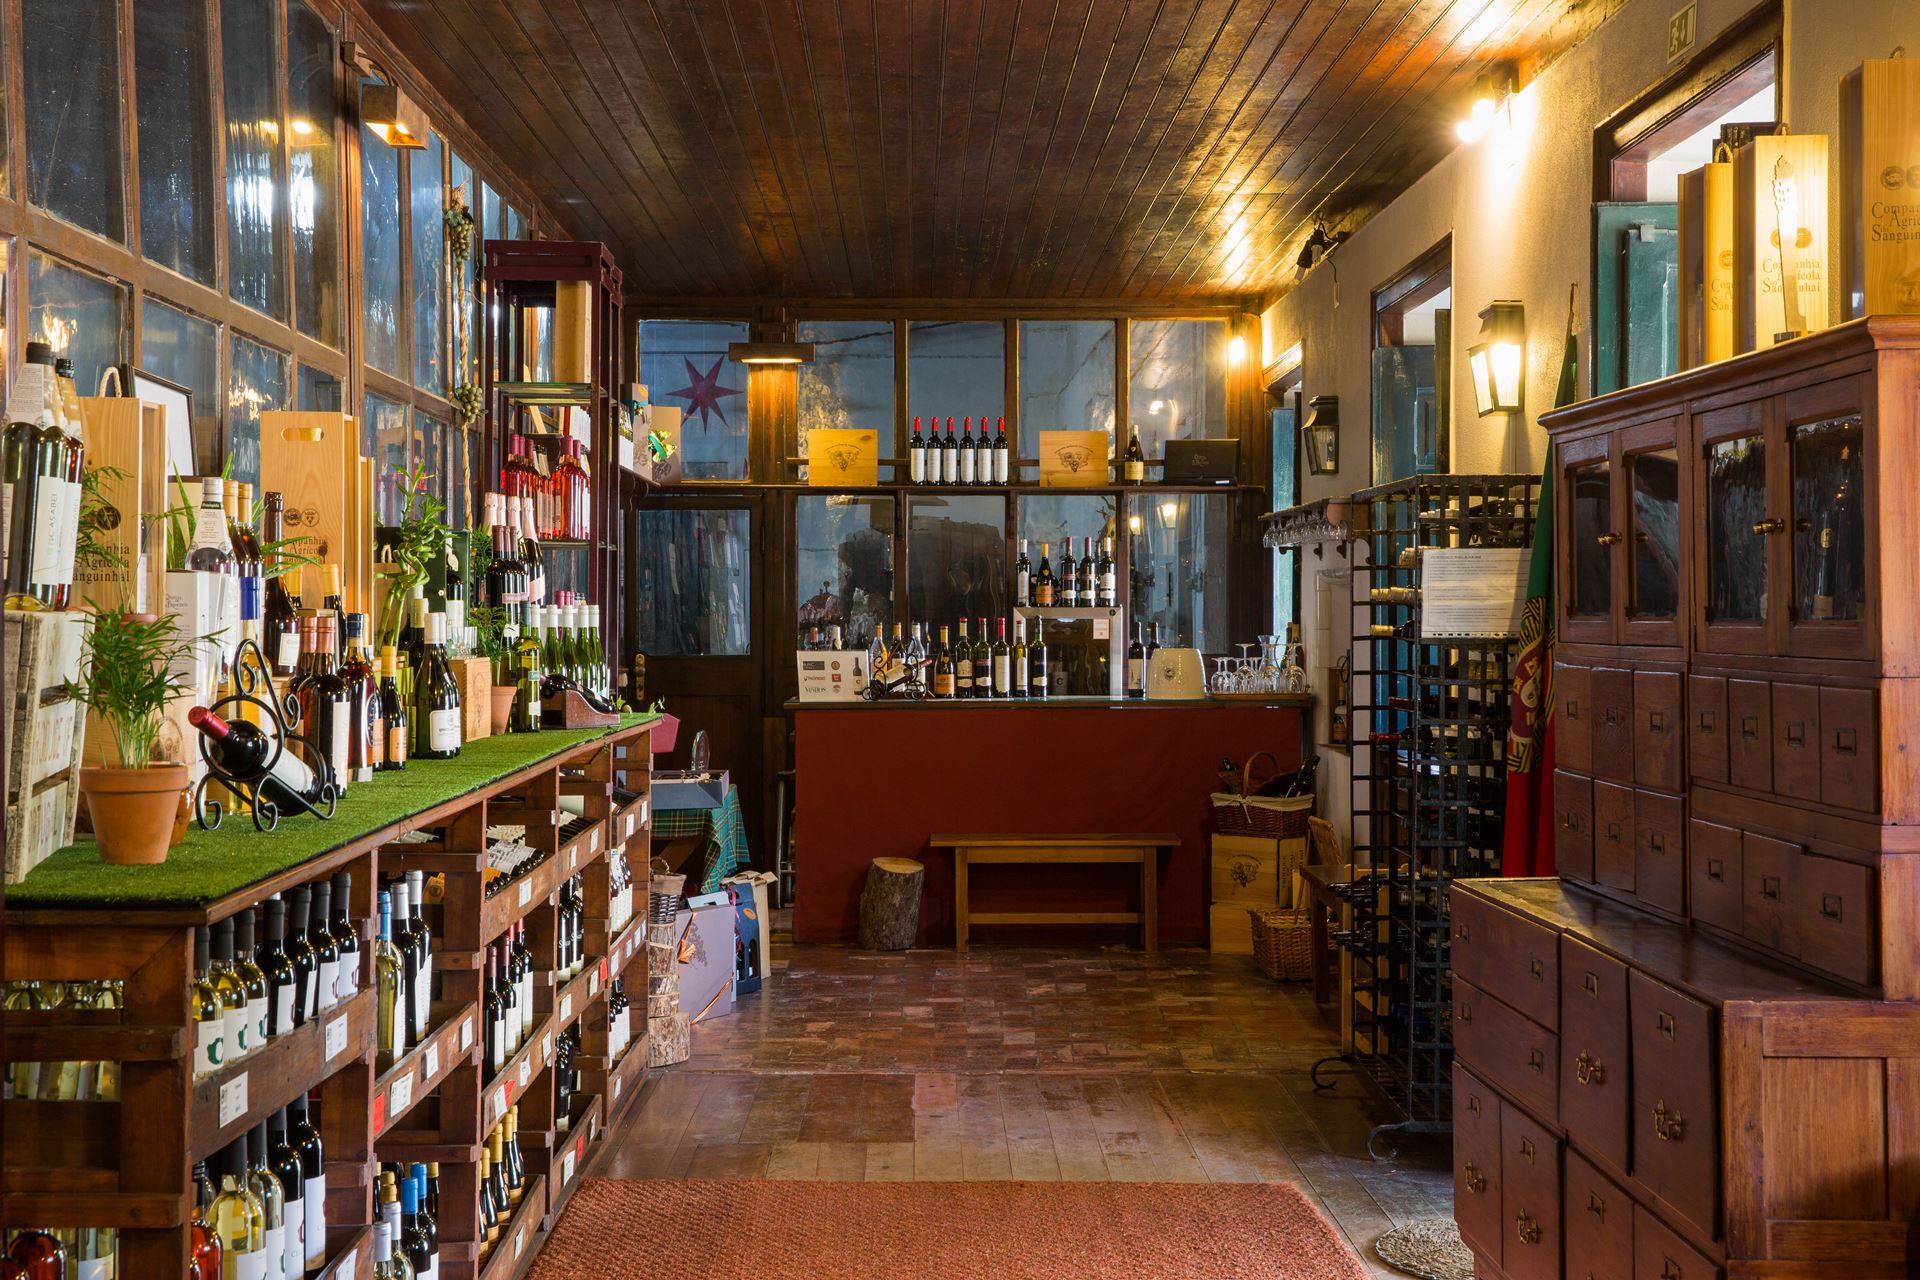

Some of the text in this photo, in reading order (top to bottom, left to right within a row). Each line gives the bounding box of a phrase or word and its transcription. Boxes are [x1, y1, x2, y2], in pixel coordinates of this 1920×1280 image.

[1871, 201, 1920, 219] Compan
[1871, 223, 1920, 244] Sanguin
[1762, 258, 1820, 274] Coanhia
[1762, 277, 1820, 293] Sannhal
[72, 571, 130, 584] anguinhal
